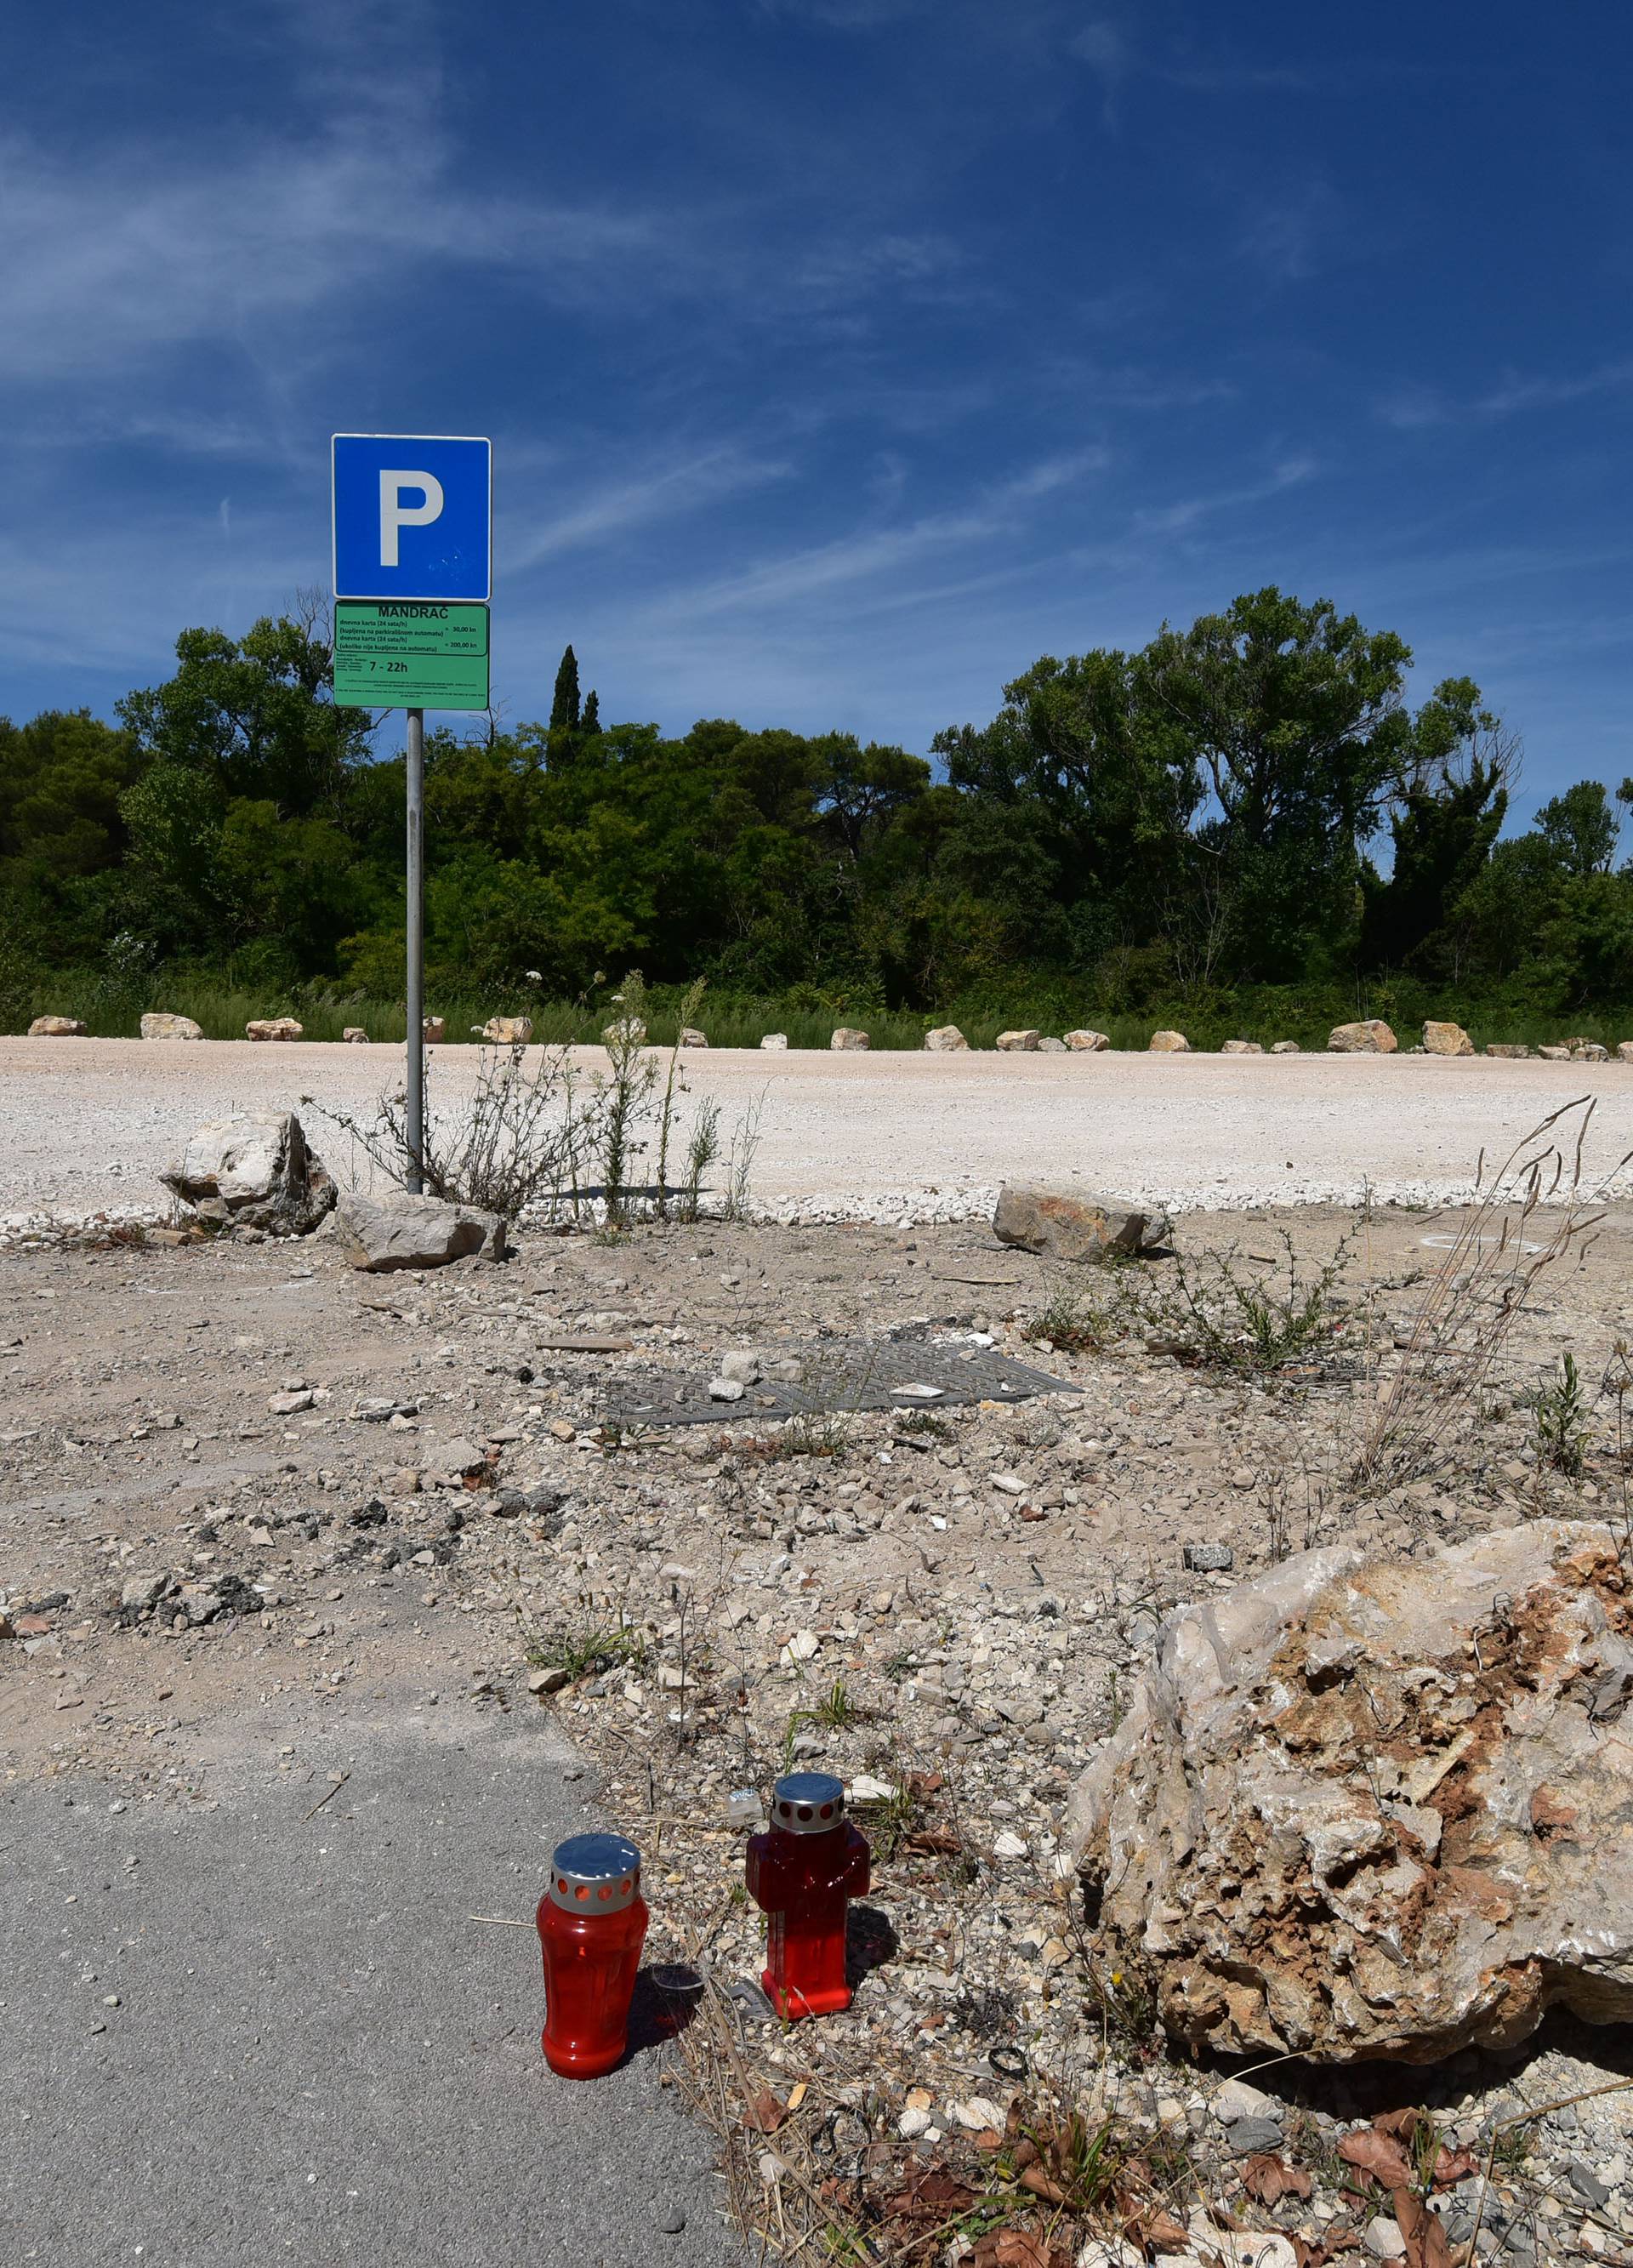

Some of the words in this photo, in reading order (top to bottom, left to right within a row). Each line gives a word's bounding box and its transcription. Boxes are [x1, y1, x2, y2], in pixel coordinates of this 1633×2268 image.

[380, 470, 444, 567] P
[378, 605, 448, 619] MANDRAČ
[370, 661, 376, 671] 7
[387, 662, 407, 672] 22h
